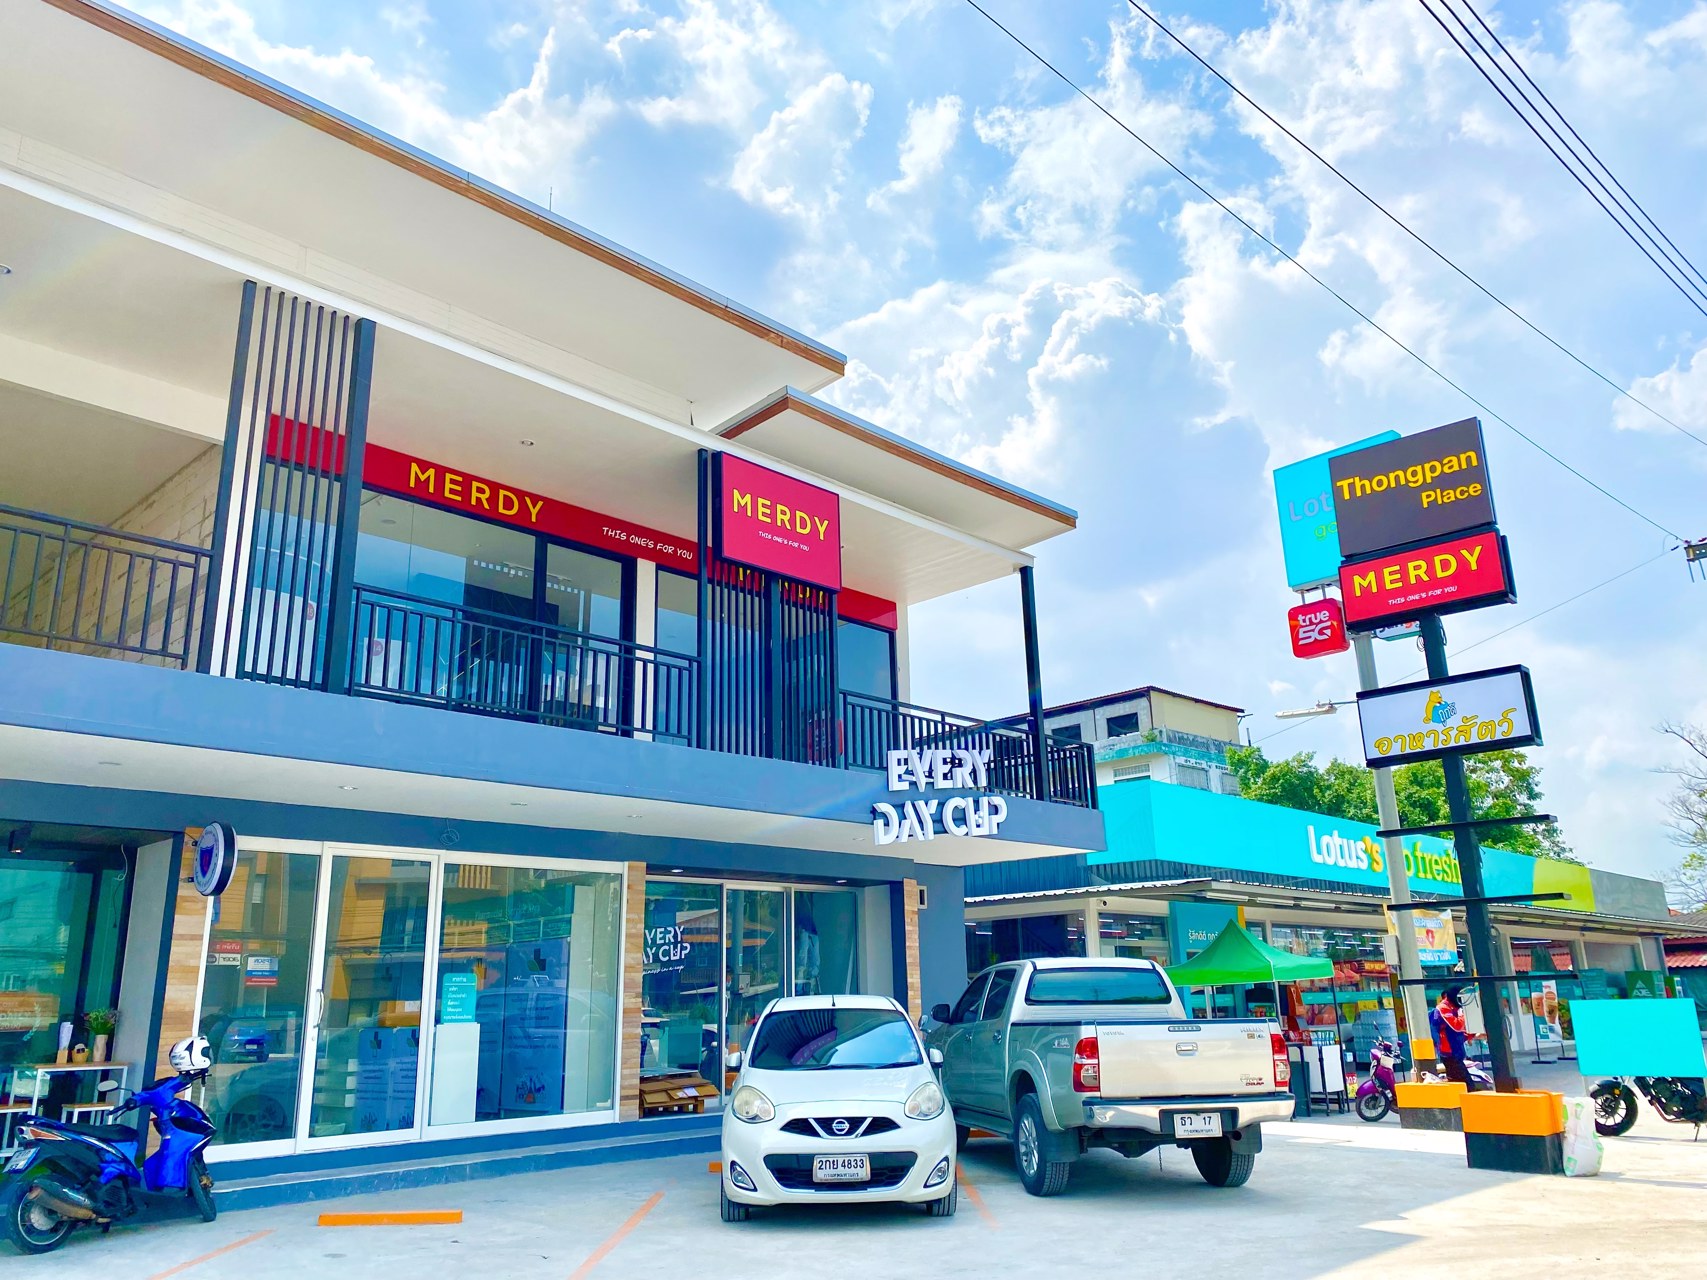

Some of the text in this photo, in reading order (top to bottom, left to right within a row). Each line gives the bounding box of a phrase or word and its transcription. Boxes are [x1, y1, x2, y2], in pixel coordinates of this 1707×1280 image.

[1336, 450, 1479, 500] Thongpan
[409, 462, 544, 523] MERDY
[1421, 482, 1482, 508] Place
[733, 488, 829, 541] MERDY
[602, 527, 693, 560] THIS ONE'S FOR YOU
[758, 531, 772, 540] THIS
[773, 535, 788, 545] ONE'S
[788, 541, 799, 549] FOR
[1353, 545, 1483, 597] MERDY
[1388, 585, 1458, 606] THIS ONE'S FOR YOU
[1298, 610, 1330, 626] true
[1298, 621, 1331, 646] 5G
[1374, 707, 1517, 756] อาหารสัตว์
[887, 749, 991, 792] EVERY
[872, 796, 1007, 846] DAY CUP
[1307, 825, 1383, 872] Lotus's
[645, 926, 684, 946] VERY
[658, 943, 690, 961] CUP
[1203, 1116, 1212, 1126] 17
[841, 1158, 864, 1169] 4833
